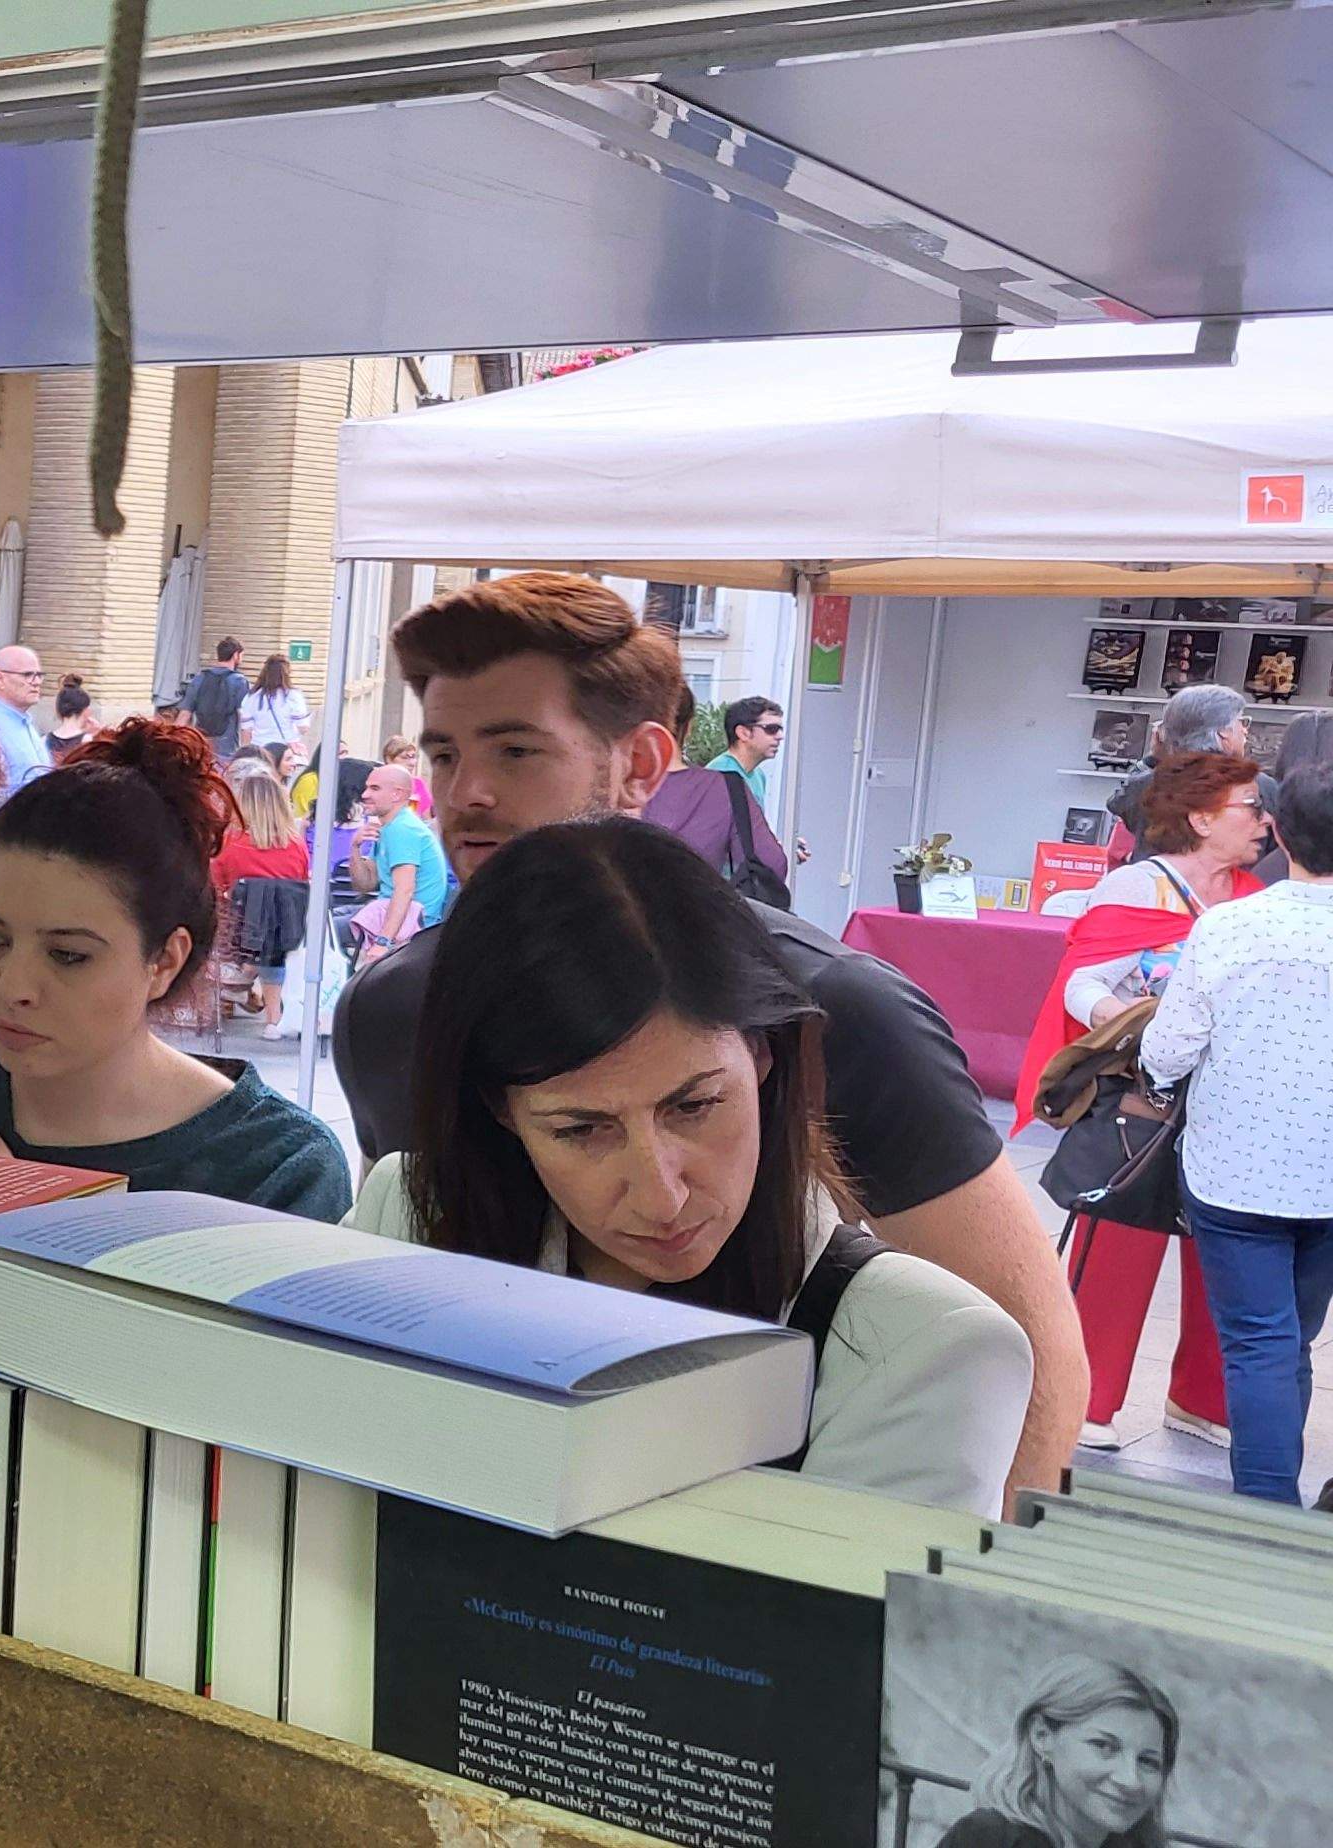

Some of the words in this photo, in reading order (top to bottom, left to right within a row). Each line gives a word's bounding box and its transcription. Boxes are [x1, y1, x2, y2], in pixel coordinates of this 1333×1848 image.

[564, 1585, 620, 1608] RANDOM
[623, 1600, 667, 1619] HOUSE
[539, 1619, 552, 1631] es
[620, 1636, 636, 1653] de
[638, 1643, 703, 1670] grandeza
[459, 1697, 483, 1710] mar
[485, 1702, 503, 1718] del
[506, 1711, 537, 1728] golfo
[540, 1718, 554, 1732] de
[557, 1723, 603, 1745] México
[605, 1740, 629, 1754] con
[632, 1747, 645, 1759] su
[649, 1751, 678, 1768] traje
[681, 1758, 697, 1772] de
[700, 1766, 763, 1791] neopreno
[570, 1708, 609, 1733] Bobby
[612, 1720, 663, 1746] Western
[667, 1738, 680, 1749] se
[683, 1743, 738, 1766] sumerge
[741, 1759, 758, 1771] en
[761, 1762, 775, 1777] el
[577, 1690, 593, 1704] El
[593, 1696, 646, 1719] pasajero
[459, 1711, 502, 1734] ilumina
[506, 1728, 521, 1740] un
[524, 1734, 558, 1750] avión
[561, 1740, 612, 1766] hundido
[614, 1760, 637, 1774] con
[641, 1764, 653, 1778] la
[657, 1768, 706, 1794] linterna
[709, 1784, 725, 1799] de
[459, 1728, 481, 1748] hay
[482, 1738, 517, 1756] nueve
[519, 1750, 565, 1770] cuerpos
[566, 1763, 590, 1778] con
[592, 1768, 604, 1782] el
[606, 1774, 660, 1799] cinturón
[661, 1789, 678, 1803] de
[681, 1797, 744, 1822] seguridad
[746, 1815, 772, 1831] aún
[459, 1746, 523, 1776] abrochado.
[525, 1764, 561, 1786] Faltan
[564, 1776, 575, 1790] la
[577, 1784, 601, 1799] caja
[604, 1791, 638, 1810] negra
[640, 1802, 650, 1814] y
[651, 1804, 662, 1817] el
[664, 1808, 711, 1830] décimo
[458, 1761, 485, 1780] Pero
[488, 1773, 527, 1792] ¿cómo
[529, 1786, 542, 1798] es
[545, 1791, 594, 1812] posible?
[595, 1802, 641, 1827] Testigo
[644, 1821, 700, 1846] colateral
